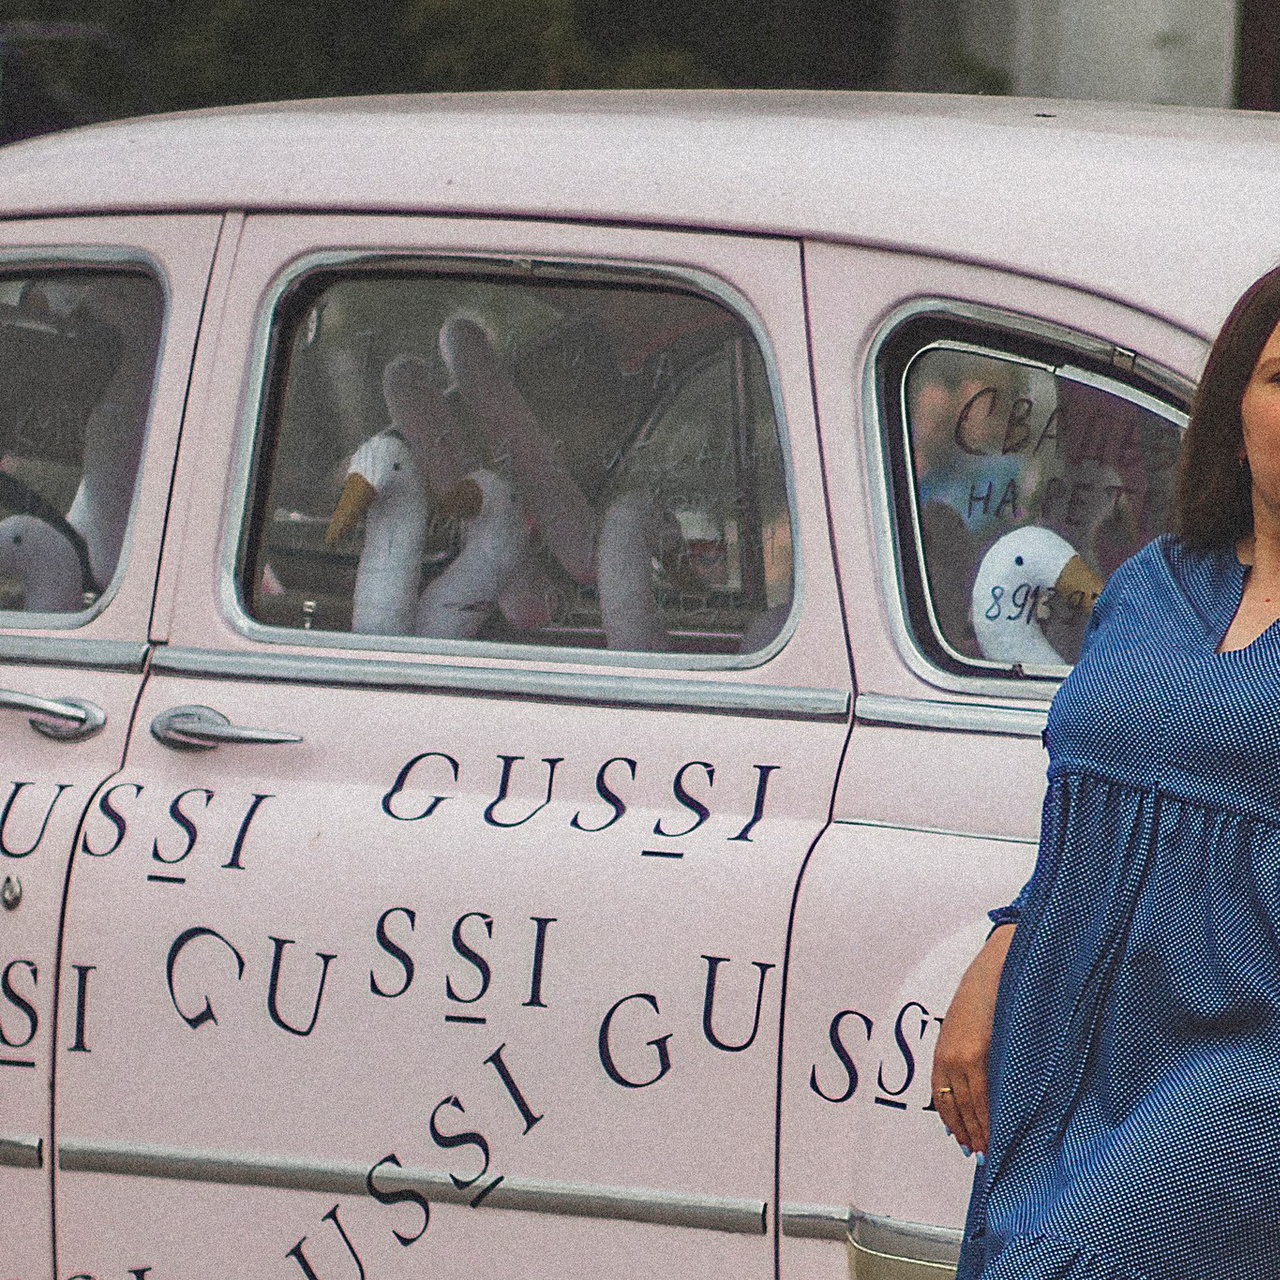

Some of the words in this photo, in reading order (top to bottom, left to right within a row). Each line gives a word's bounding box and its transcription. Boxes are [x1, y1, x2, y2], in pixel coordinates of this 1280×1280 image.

[966, 480, 1020, 520] НА
[0, 780, 276, 884] USSI
[381, 751, 781, 858] GUSSI
[166, 907, 557, 1036] GUSSI
